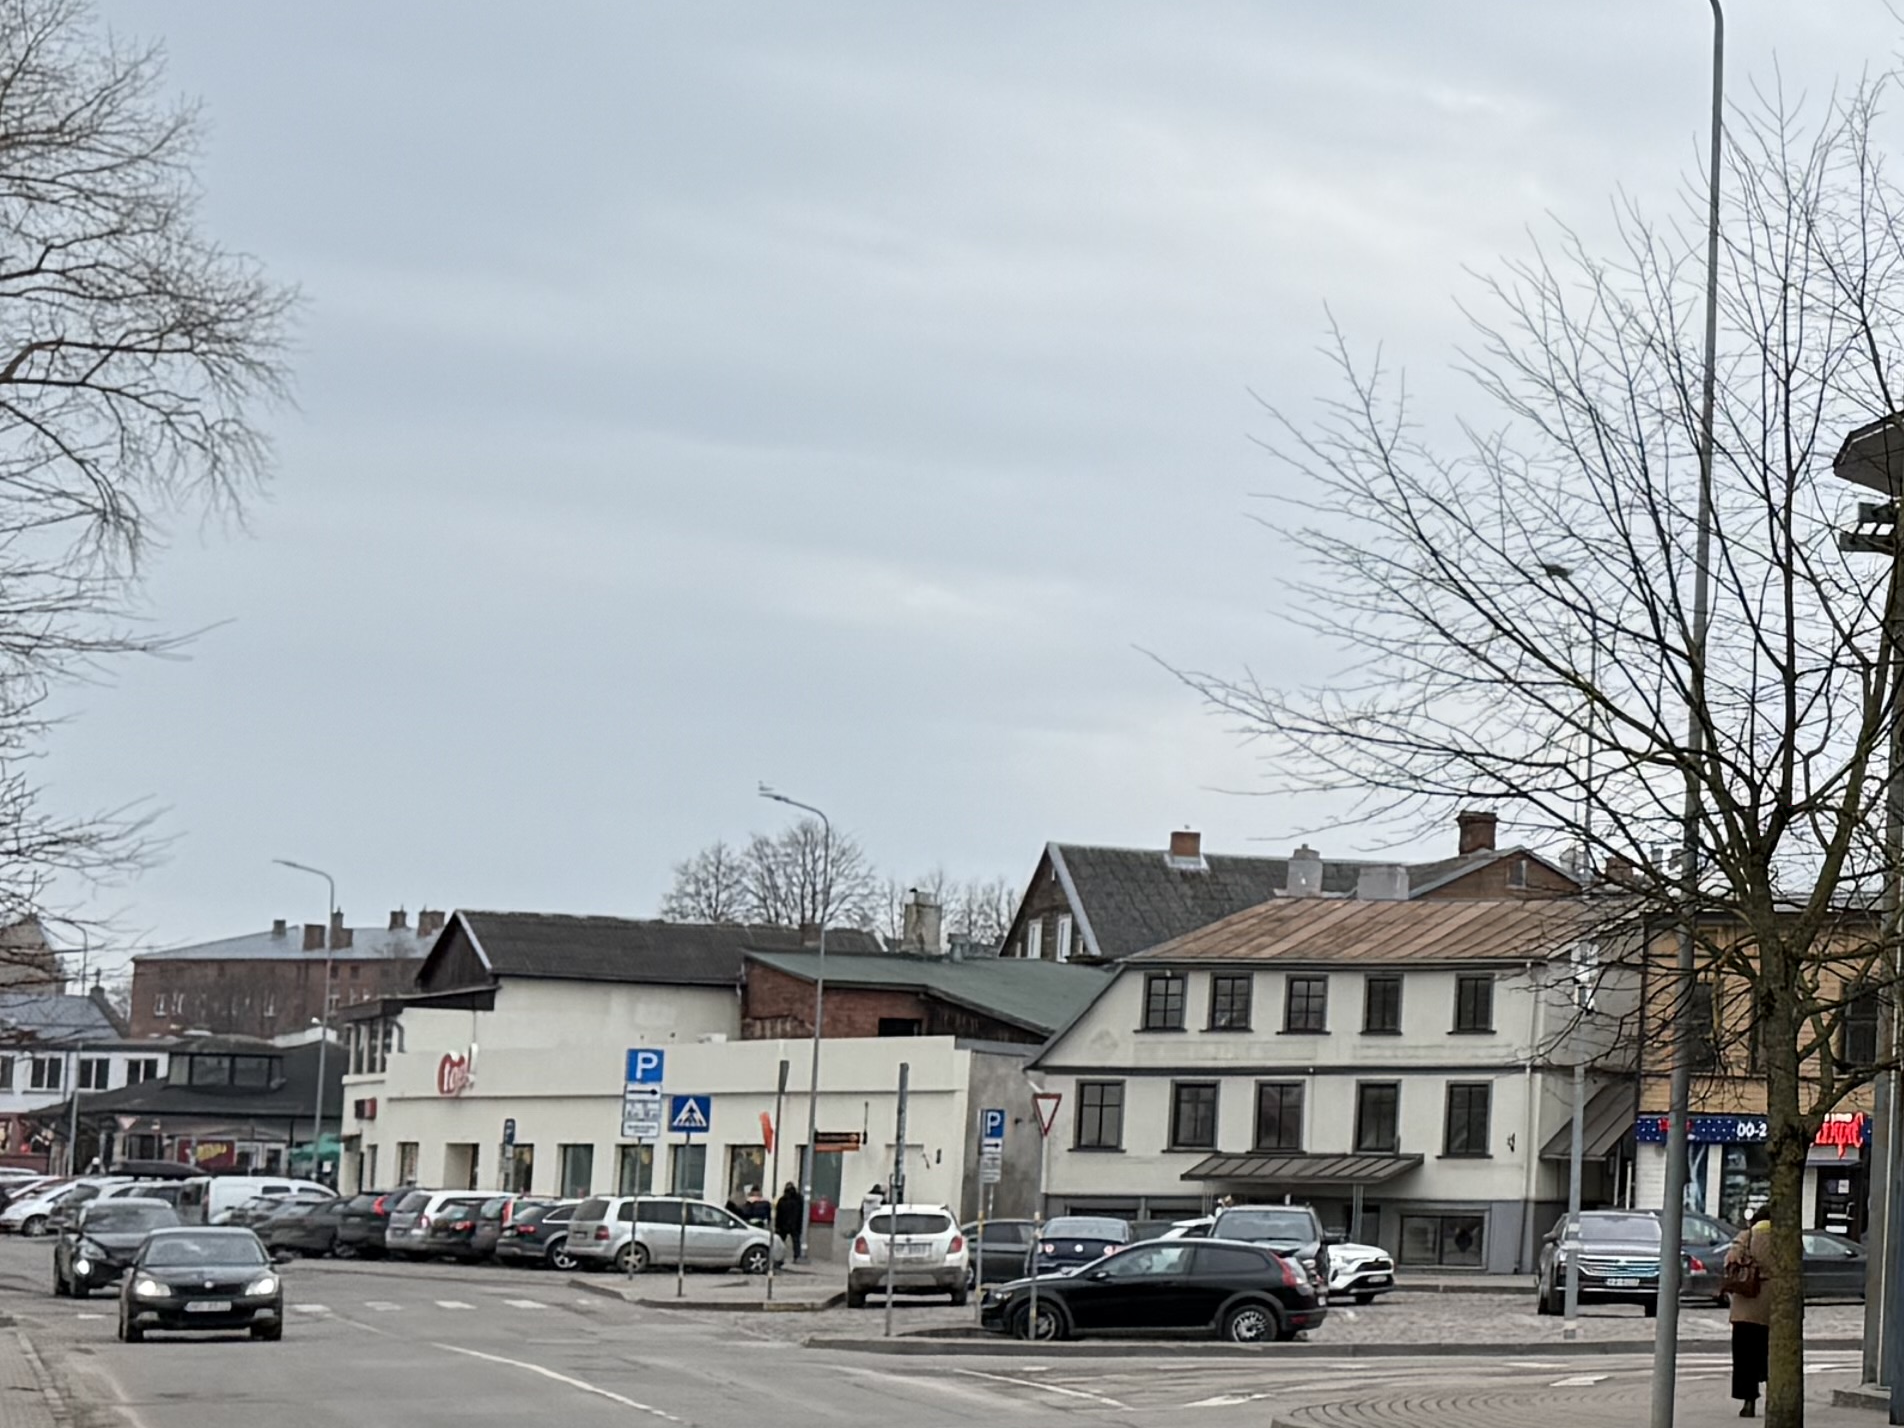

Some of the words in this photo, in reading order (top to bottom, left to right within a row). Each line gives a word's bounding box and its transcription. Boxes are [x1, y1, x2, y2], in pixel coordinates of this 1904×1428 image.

[636, 1052, 658, 1079] P
[987, 1112, 1001, 1135] P
[1736, 1122, 1768, 1139] 00-2
